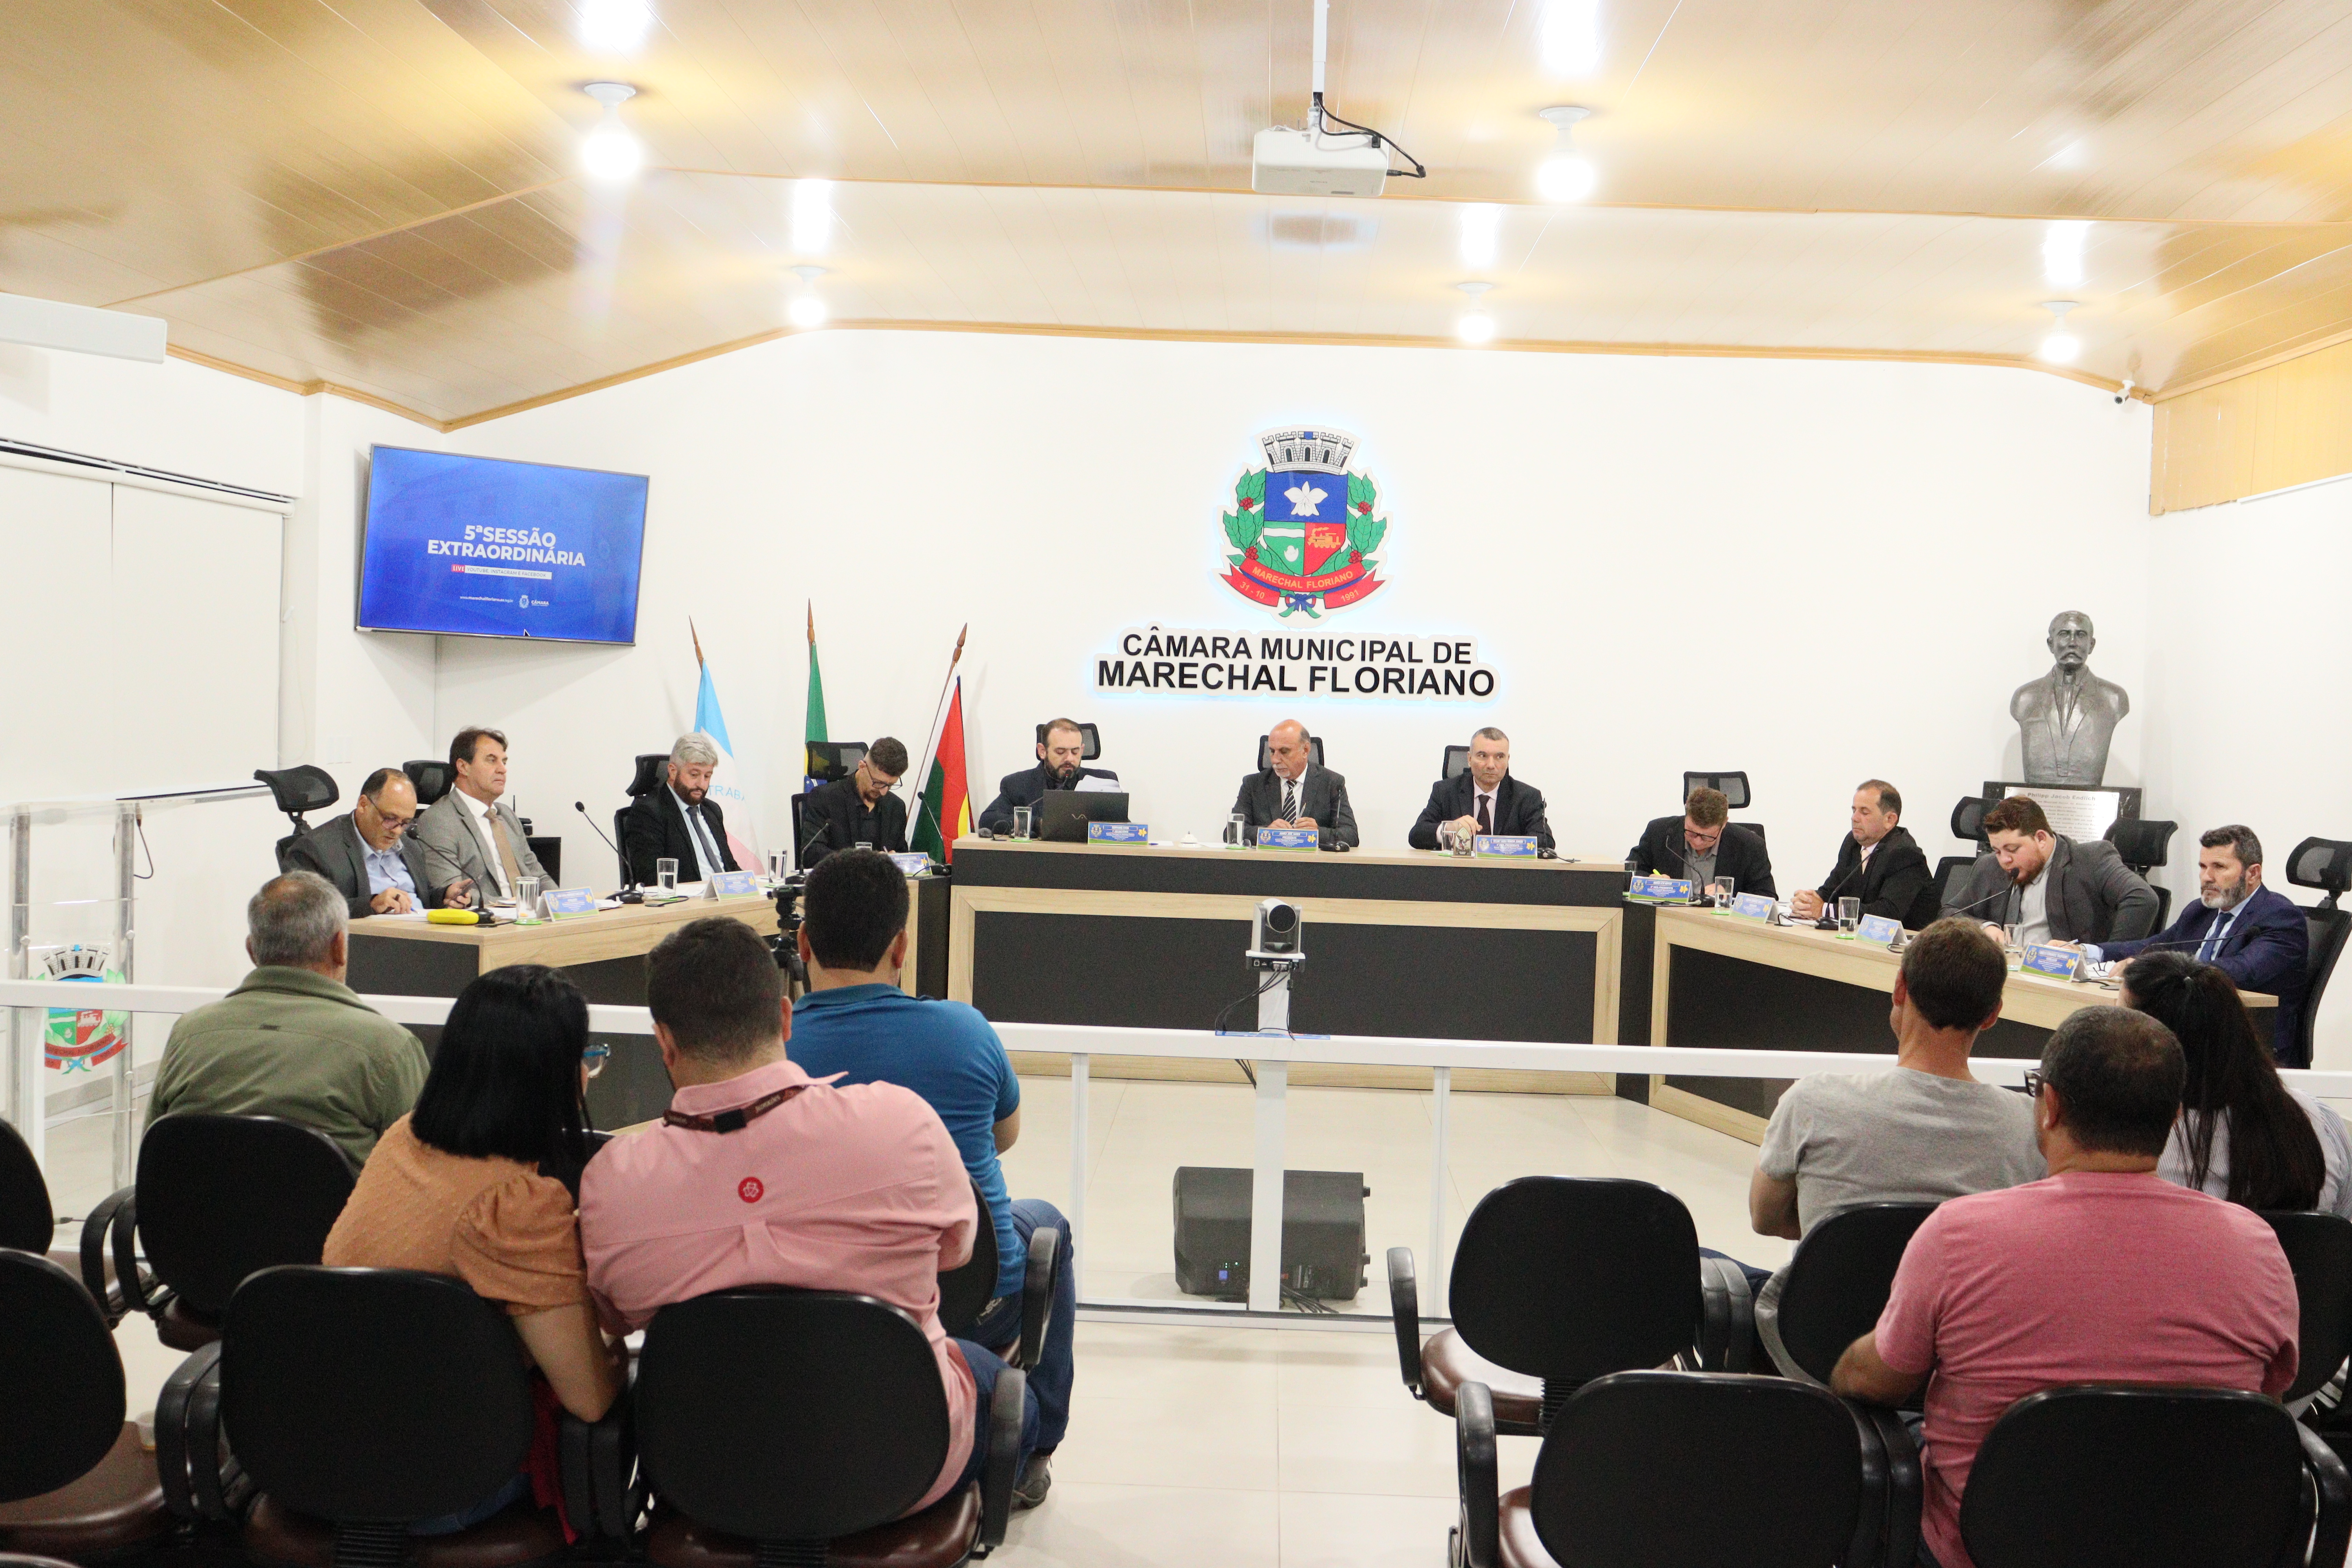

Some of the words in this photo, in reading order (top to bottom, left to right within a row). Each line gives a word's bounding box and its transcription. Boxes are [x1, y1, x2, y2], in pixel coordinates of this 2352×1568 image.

[428, 539, 585, 566] EXTRAORDINÁRIA
[1252, 566, 1303, 588] MARECHAL
[1307, 570, 1353, 588] FLORIANO
[1240, 581, 1250, 591] 31
[1256, 591, 1265, 599] 10
[1341, 589, 1359, 602] 1991
[1124, 626, 1252, 659] CÂMARA
[1262, 638, 1423, 663] MUNICIPAL
[1434, 642, 1471, 664] DE
[1099, 661, 1297, 691] MARECHAL
[1310, 666, 1494, 696] FLORIANO
